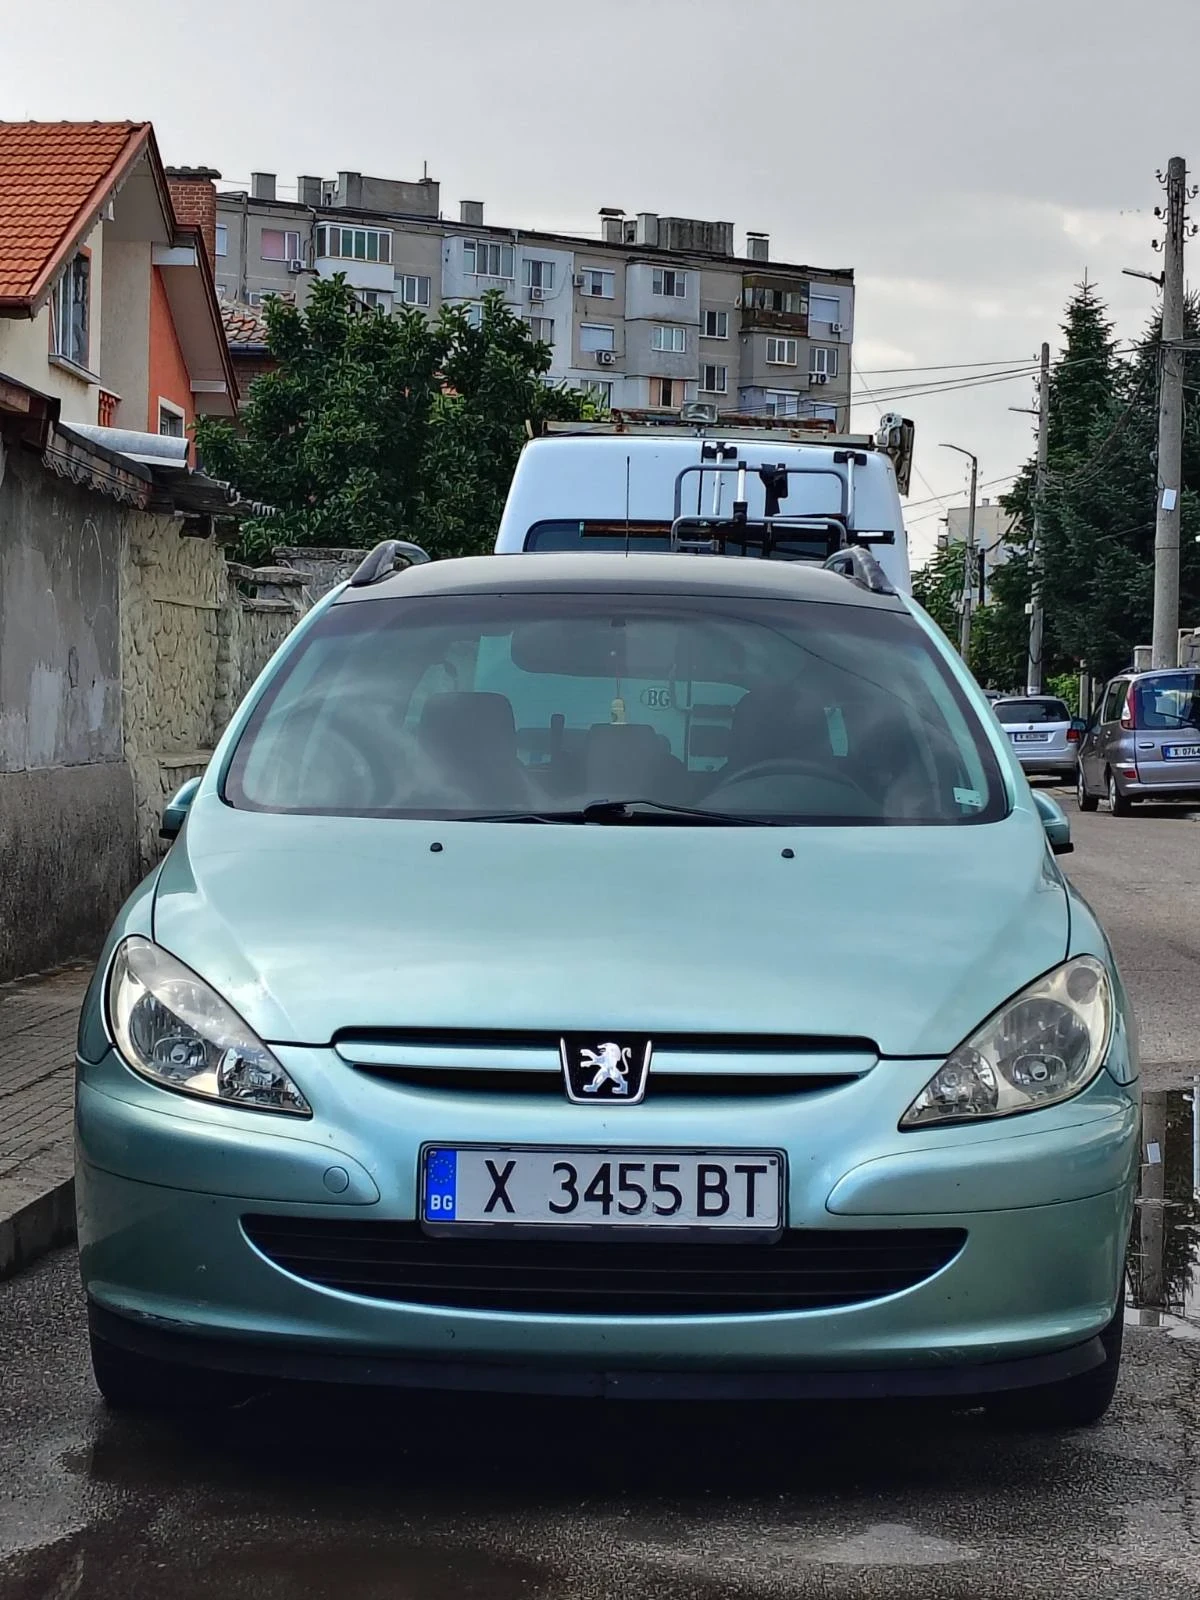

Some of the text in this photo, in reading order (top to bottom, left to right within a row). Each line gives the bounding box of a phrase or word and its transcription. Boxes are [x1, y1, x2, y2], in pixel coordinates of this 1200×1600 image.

[647, 689, 671, 707] BG
[484, 1160, 516, 1213] X
[430, 1194, 453, 1210] BG
